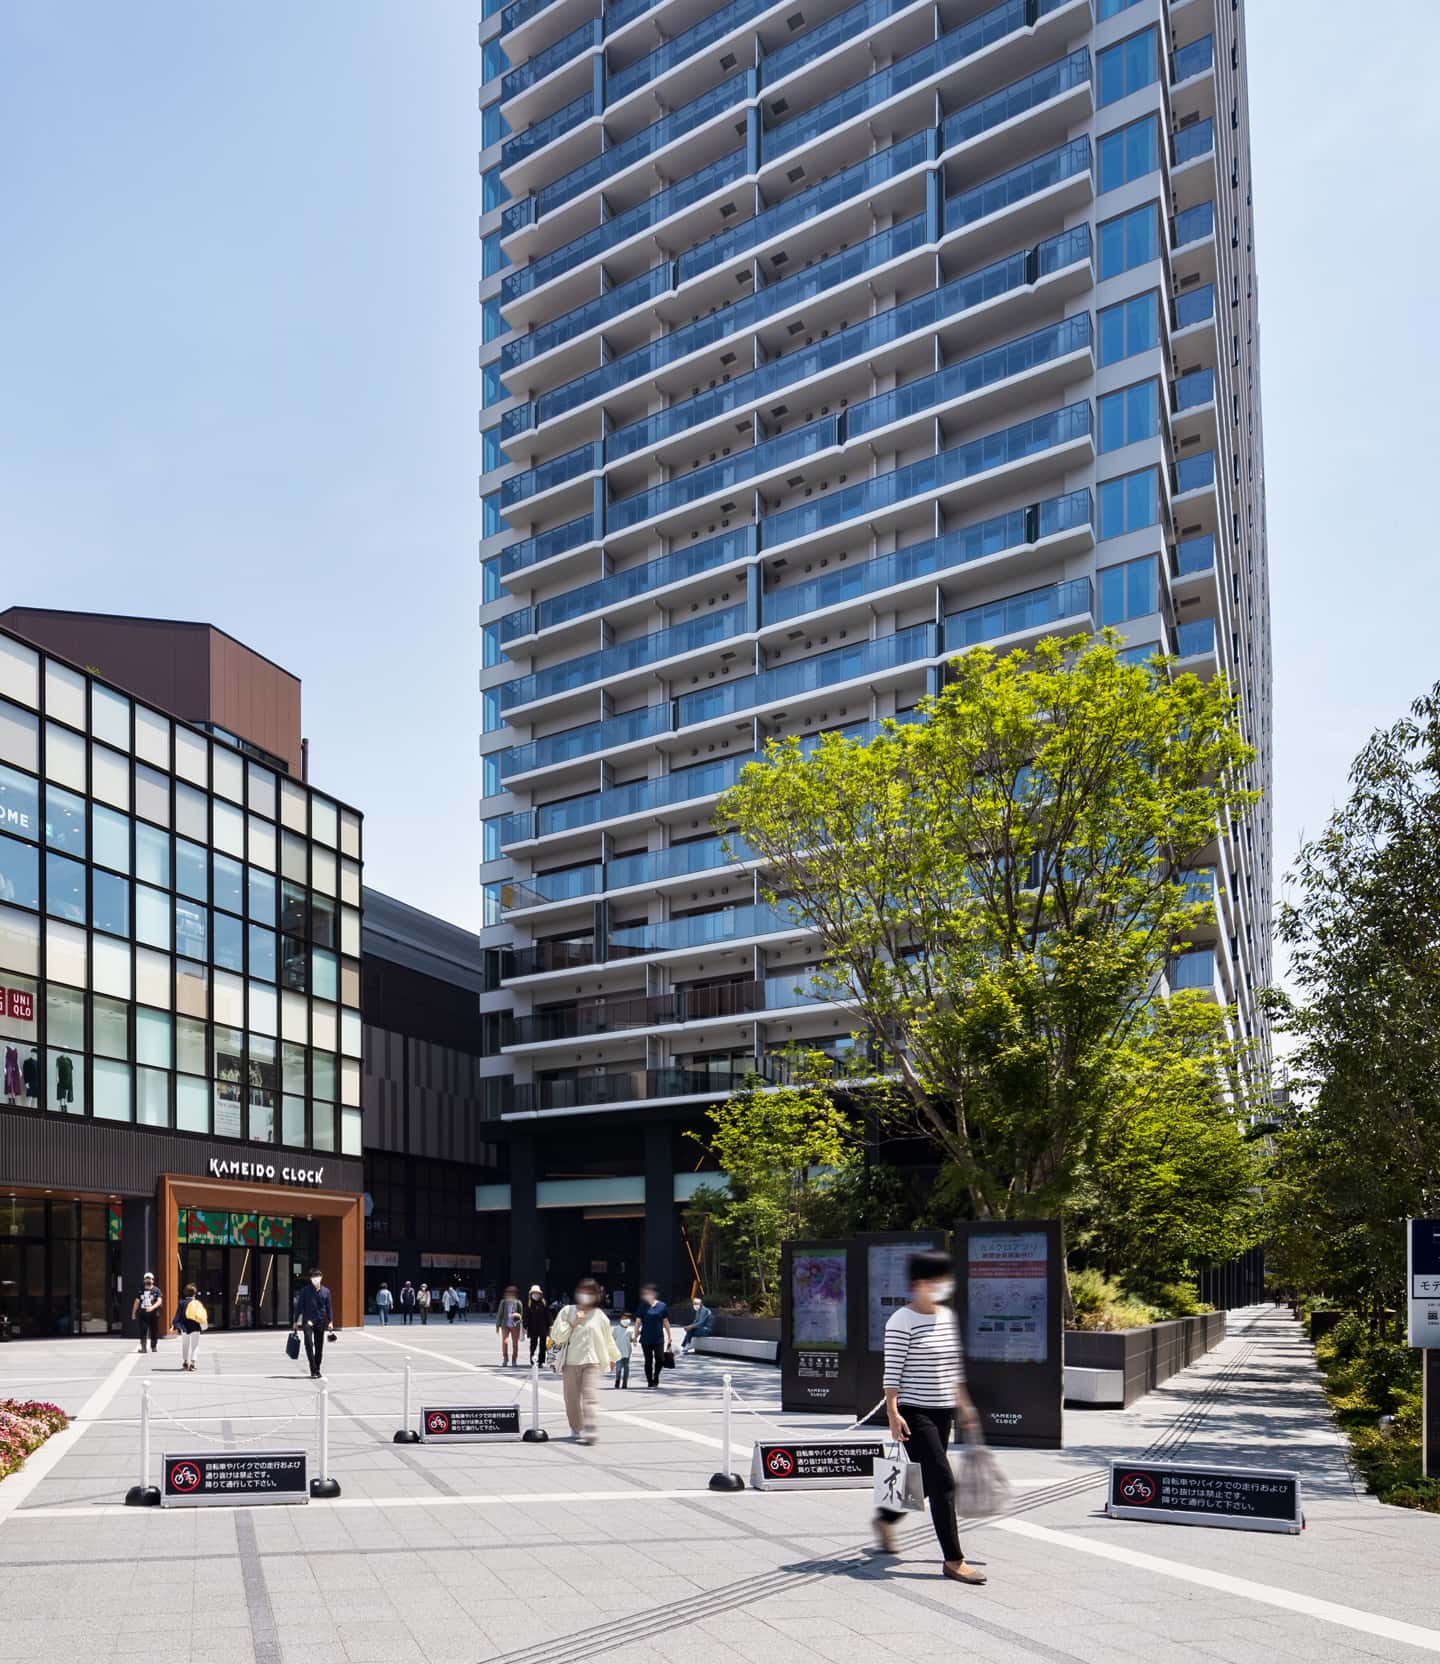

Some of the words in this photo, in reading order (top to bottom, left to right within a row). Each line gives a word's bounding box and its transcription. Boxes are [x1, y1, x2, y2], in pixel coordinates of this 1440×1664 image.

[13, 993, 30, 1006] UNI
[13, 1005, 31, 1017] QLO
[210, 1158, 275, 1178] KAMEIDO
[282, 1167, 324, 1184] CLOCK
[1162, 1477, 1288, 1493] 自転車やバイクでの走行および
